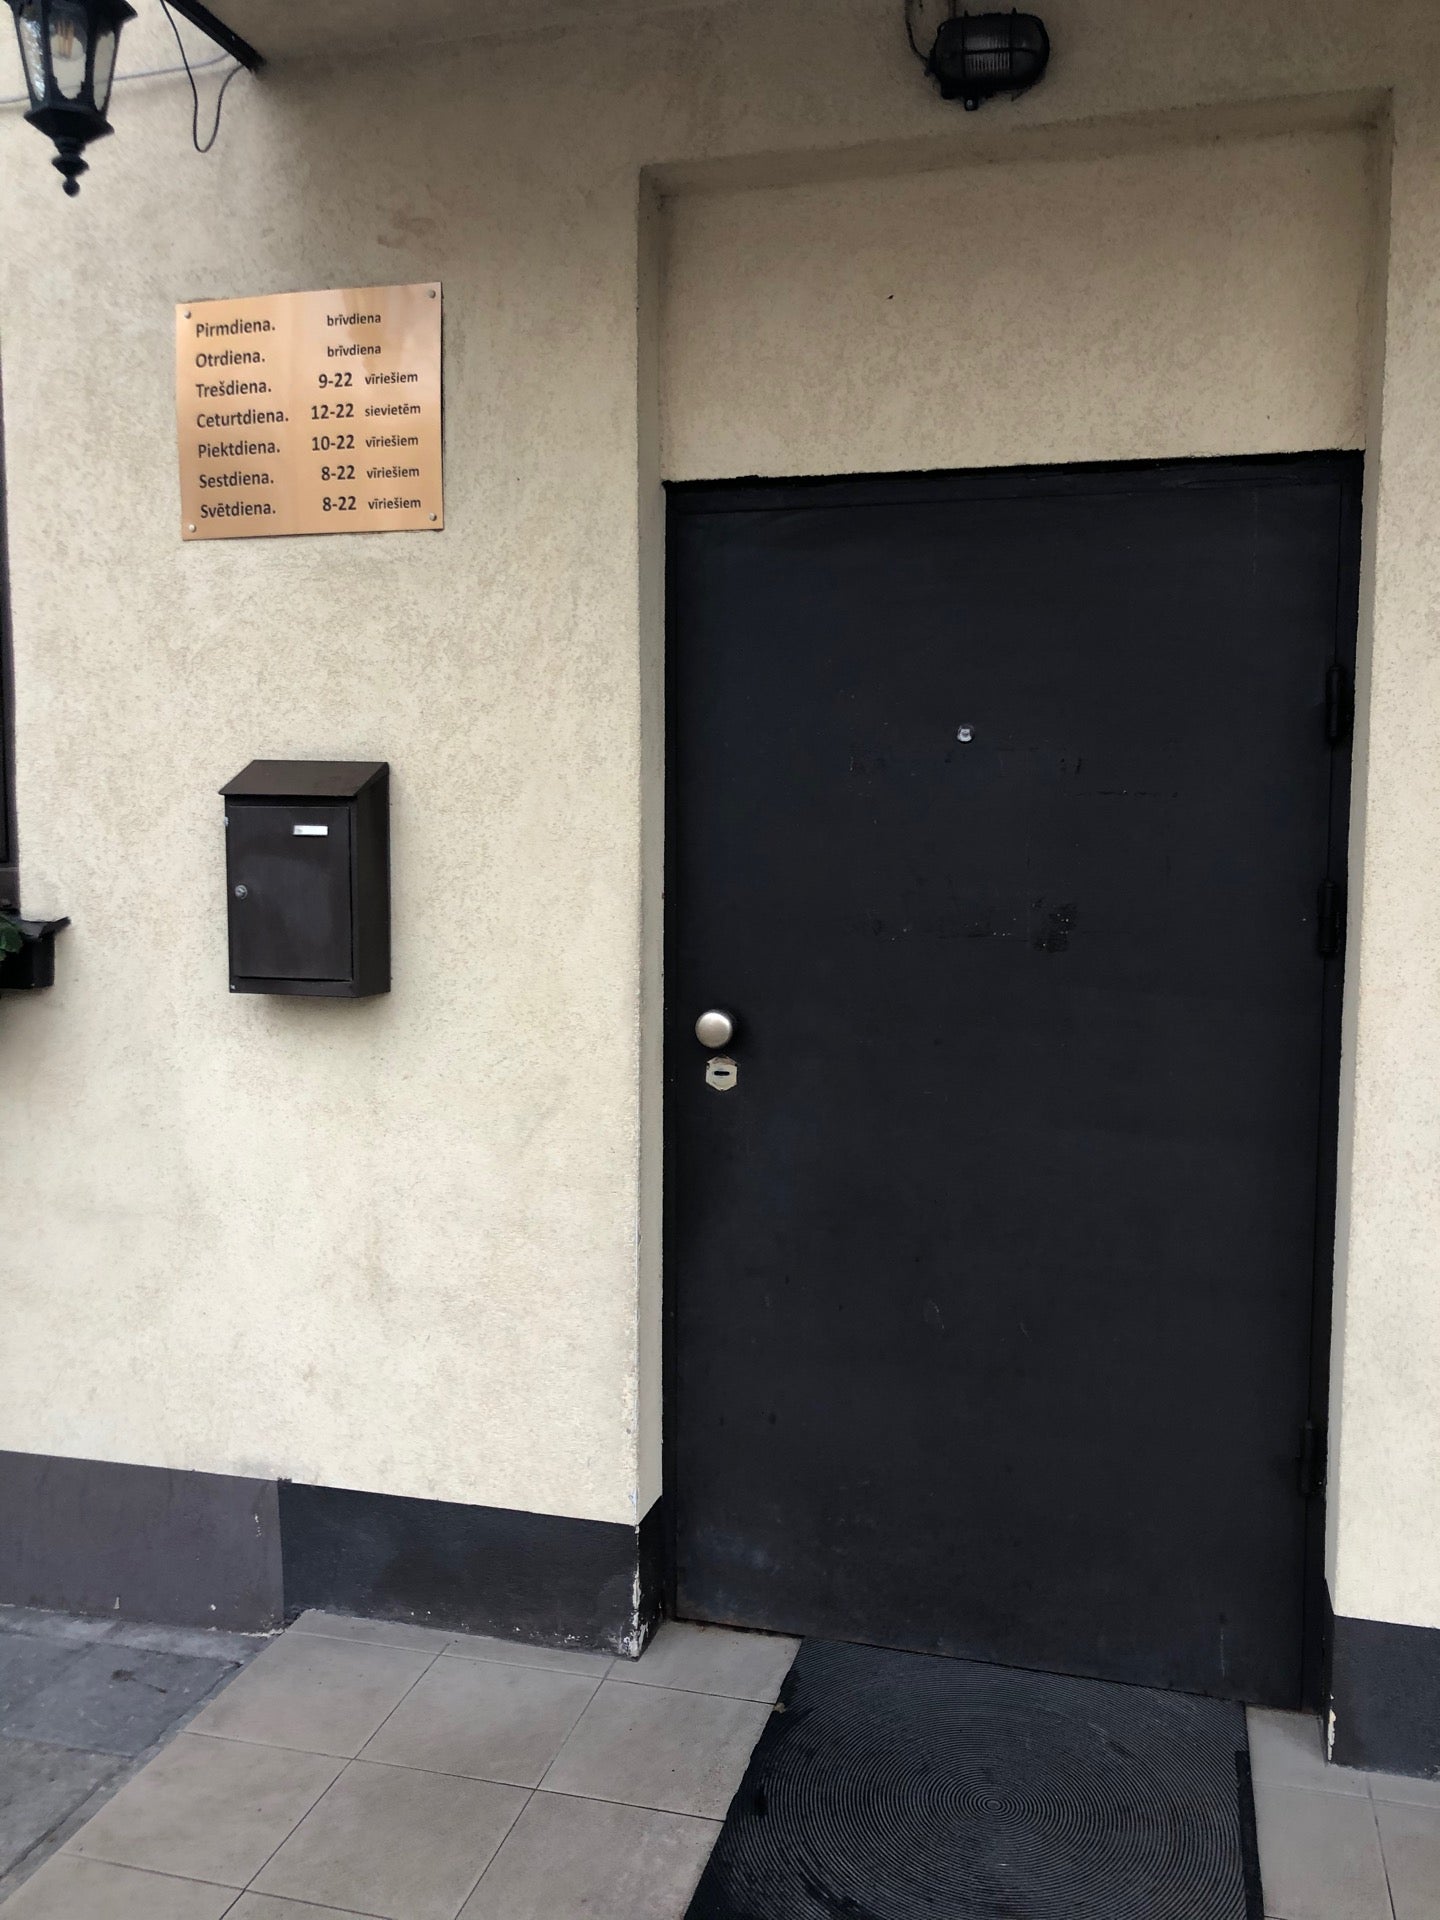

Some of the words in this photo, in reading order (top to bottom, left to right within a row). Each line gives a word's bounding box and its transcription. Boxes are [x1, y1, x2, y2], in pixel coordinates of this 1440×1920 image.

[196, 318, 276, 338] Pirmdiena.
[327, 313, 381, 327] brīvdiena
[195, 351, 265, 368] Otrdiena.
[327, 344, 381, 357] brīvdiena
[196, 380, 271, 398] Trešdiena.
[318, 372, 353, 388] 9-22
[365, 372, 418, 385] vīriešiem
[197, 409, 289, 429] Ceturtdiena.
[311, 403, 354, 420] 12-22
[365, 404, 421, 417] sievietēm
[199, 440, 280, 458] Piektdiena.
[312, 434, 354, 451] 10-22
[366, 435, 418, 448] vīriešiem
[199, 471, 274, 489] Sestdiena.
[321, 465, 355, 481] 8-22
[366, 467, 419, 479] vīriešiem
[201, 502, 276, 519] Svētdiena.
[322, 496, 356, 512] 8-22
[368, 498, 421, 510] vīriešiem
